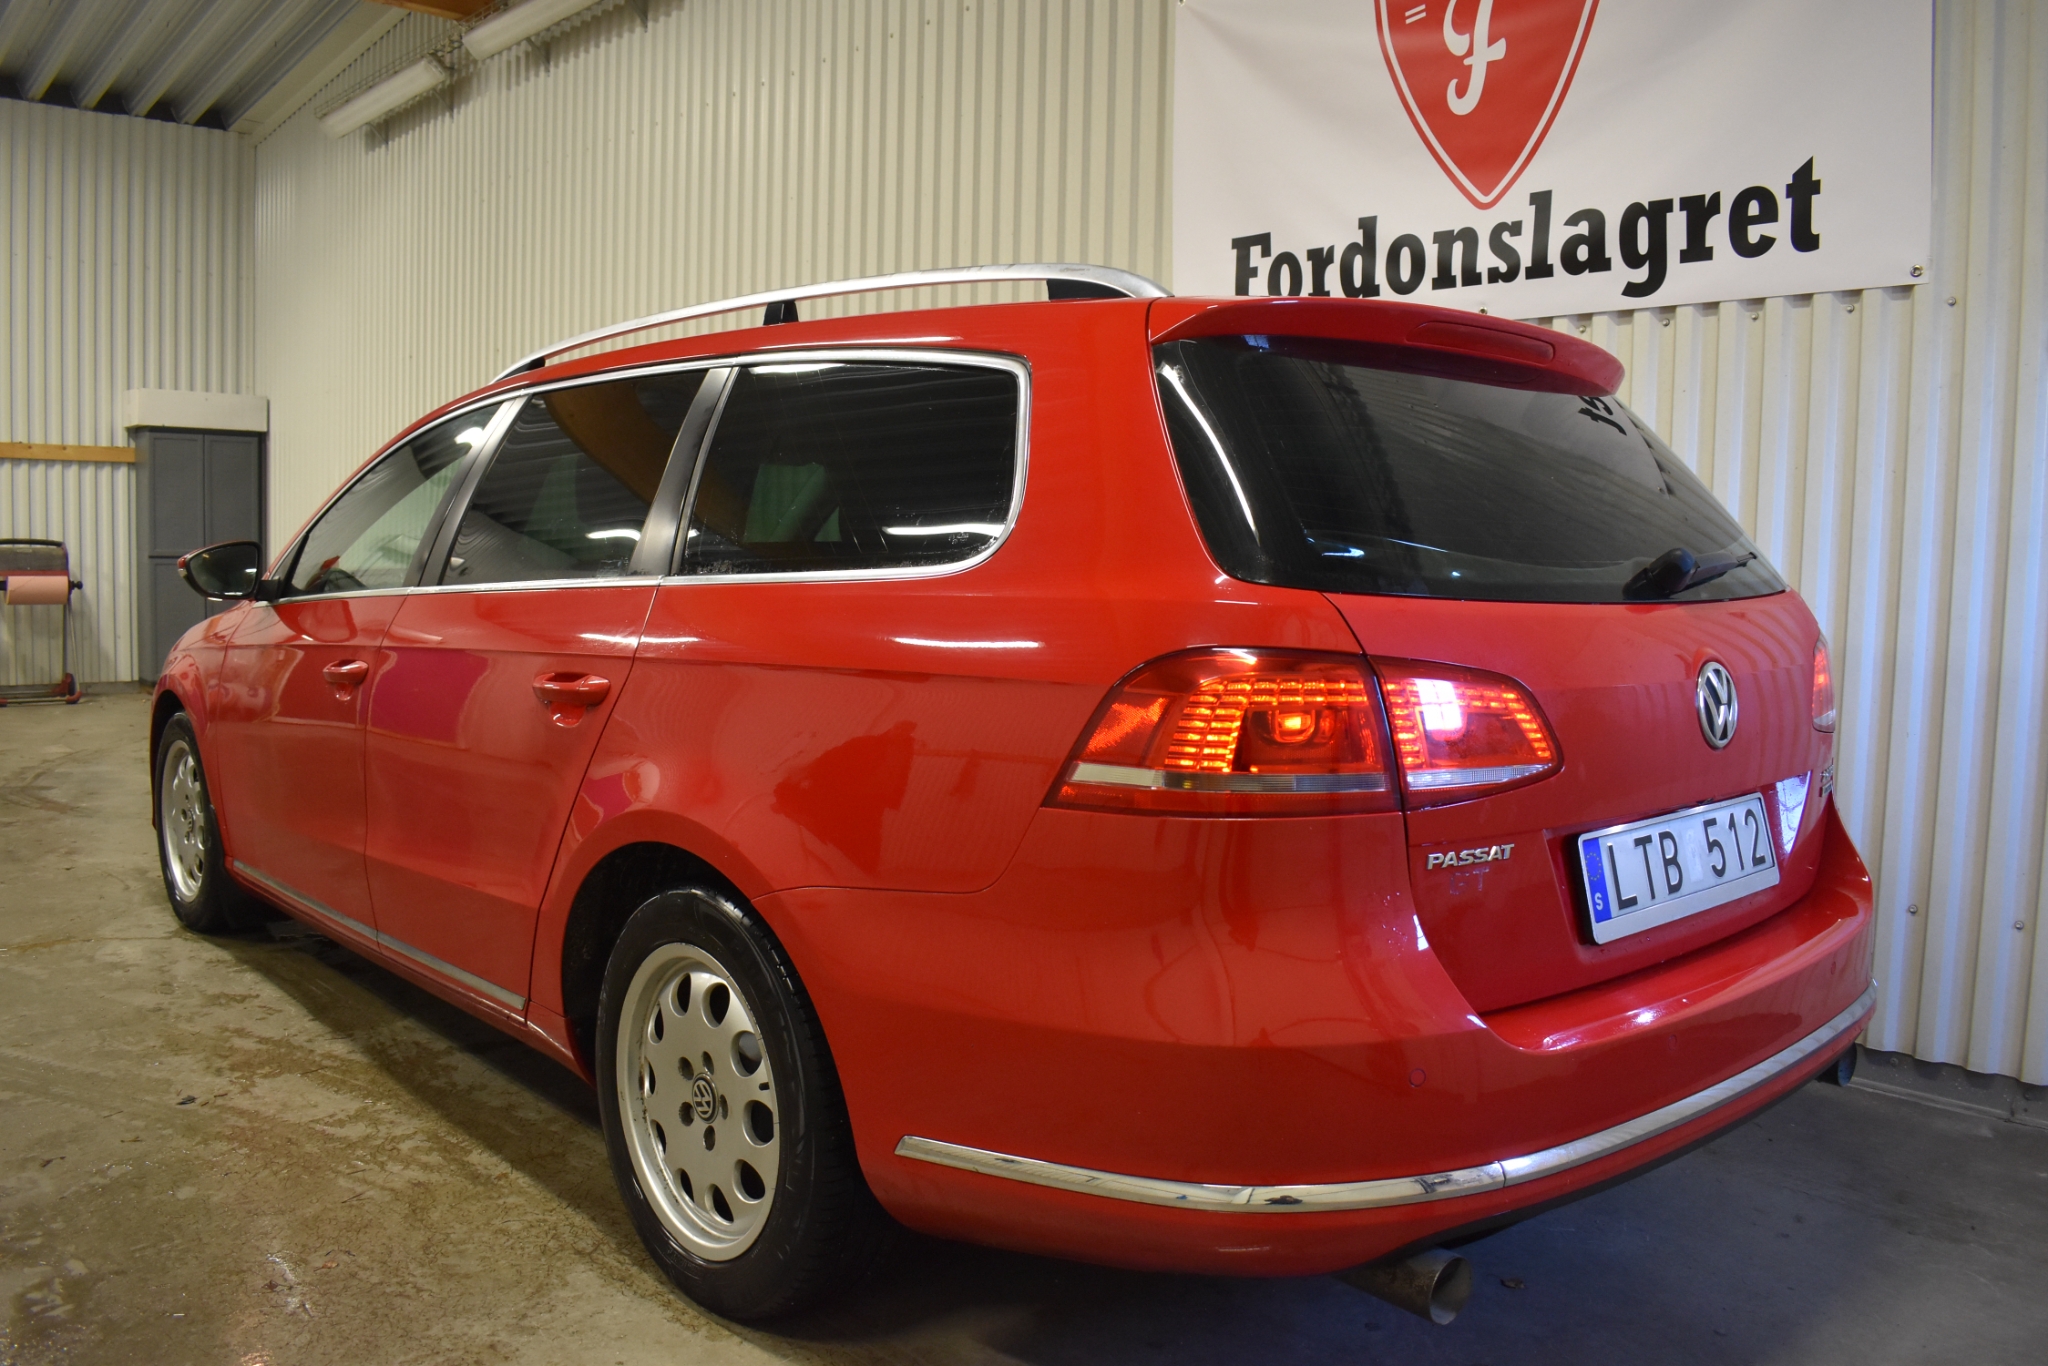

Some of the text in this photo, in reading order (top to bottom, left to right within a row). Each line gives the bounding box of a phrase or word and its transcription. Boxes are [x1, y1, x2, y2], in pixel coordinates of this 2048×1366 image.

[1231, 155, 1822, 298] Fordonslagret
[1426, 843, 1515, 870] PASSAT
[1606, 808, 1767, 910] LTB 512
[1594, 892, 1604, 911] S
